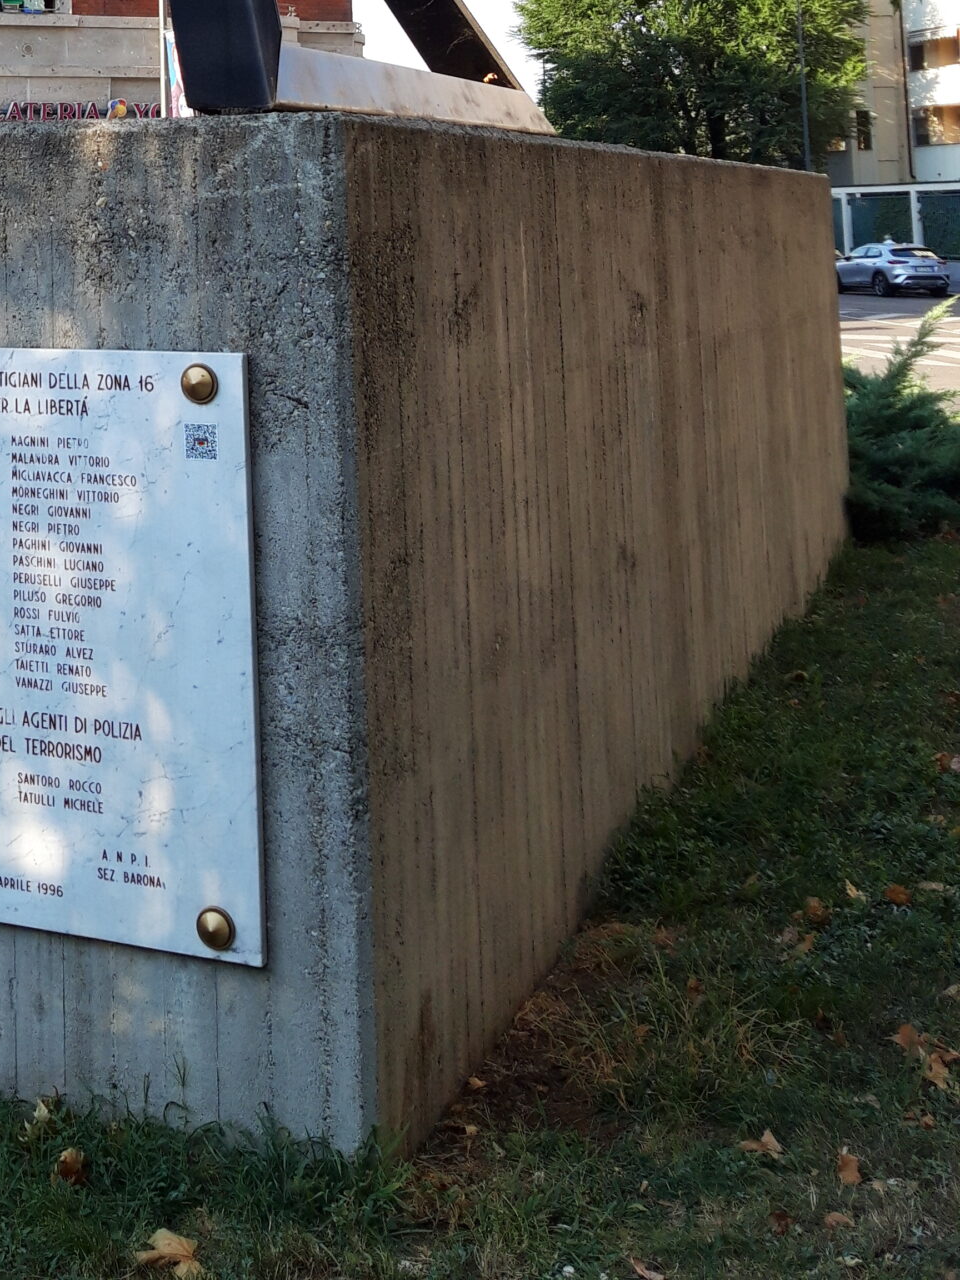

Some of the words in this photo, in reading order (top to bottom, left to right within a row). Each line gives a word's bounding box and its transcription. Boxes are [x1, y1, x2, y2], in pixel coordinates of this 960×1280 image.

[49, 373, 90, 390] DELLA
[97, 374, 131, 391] ZONA
[139, 375, 154, 392] 16
[15, 398, 31, 414] LA
[11, 435, 49, 448] MAGNINI
[58, 438, 89, 449] PIETRO
[12, 452, 59, 465] MALANDRA
[69, 455, 110, 468] VITTORIO
[12, 469, 72, 483] MIGLIAVACCA
[81, 473, 137, 487] FRANCESCO
[12, 487, 68, 501] MORNEGHINI
[77, 490, 119, 504] VITTORIO
[12, 504, 39, 516] NEGRI
[48, 506, 91, 519] GIOVANNI
[13, 521, 39, 533] NEGRI
[48, 523, 80, 536] PIETRO
[12, 538, 50, 551] PAGHINI
[60, 541, 103, 555] GIOVANNI
[13, 555, 56, 568] PASCHINI
[65, 559, 104, 573] LUCIANO
[13, 572, 62, 587] PERUSELLI
[71, 577, 116, 592] GIUSEPPE
[14, 589, 46, 603] PILUSO
[55, 593, 102, 608] GREGORIO
[14, 607, 40, 620] ROSSI
[48, 609, 80, 623] FULVIO
[15, 624, 41, 637] SATTA
[50, 627, 85, 642] ETTORE
[15, 641, 57, 656] STURARO
[66, 646, 94, 660] ALVEZ
[16, 659, 48, 673] TAIETTI
[57, 663, 91, 677] RENATO
[16, 676, 53, 691] VANAZZI
[62, 681, 107, 698] GIUSEPPE
[22, 710, 67, 731] AGENTI
[75, 717, 87, 734] DI
[94, 719, 142, 741] POLIZIA
[25, 737, 102, 763] TERRORISMO
[18, 772, 60, 789] SANTORO
[69, 779, 102, 794] ROCCO
[18, 791, 55, 808] TATULLI
[64, 797, 104, 814] MICHELE
[124, 871, 162, 888] BARONA
[38, 882, 64, 898] 1996
